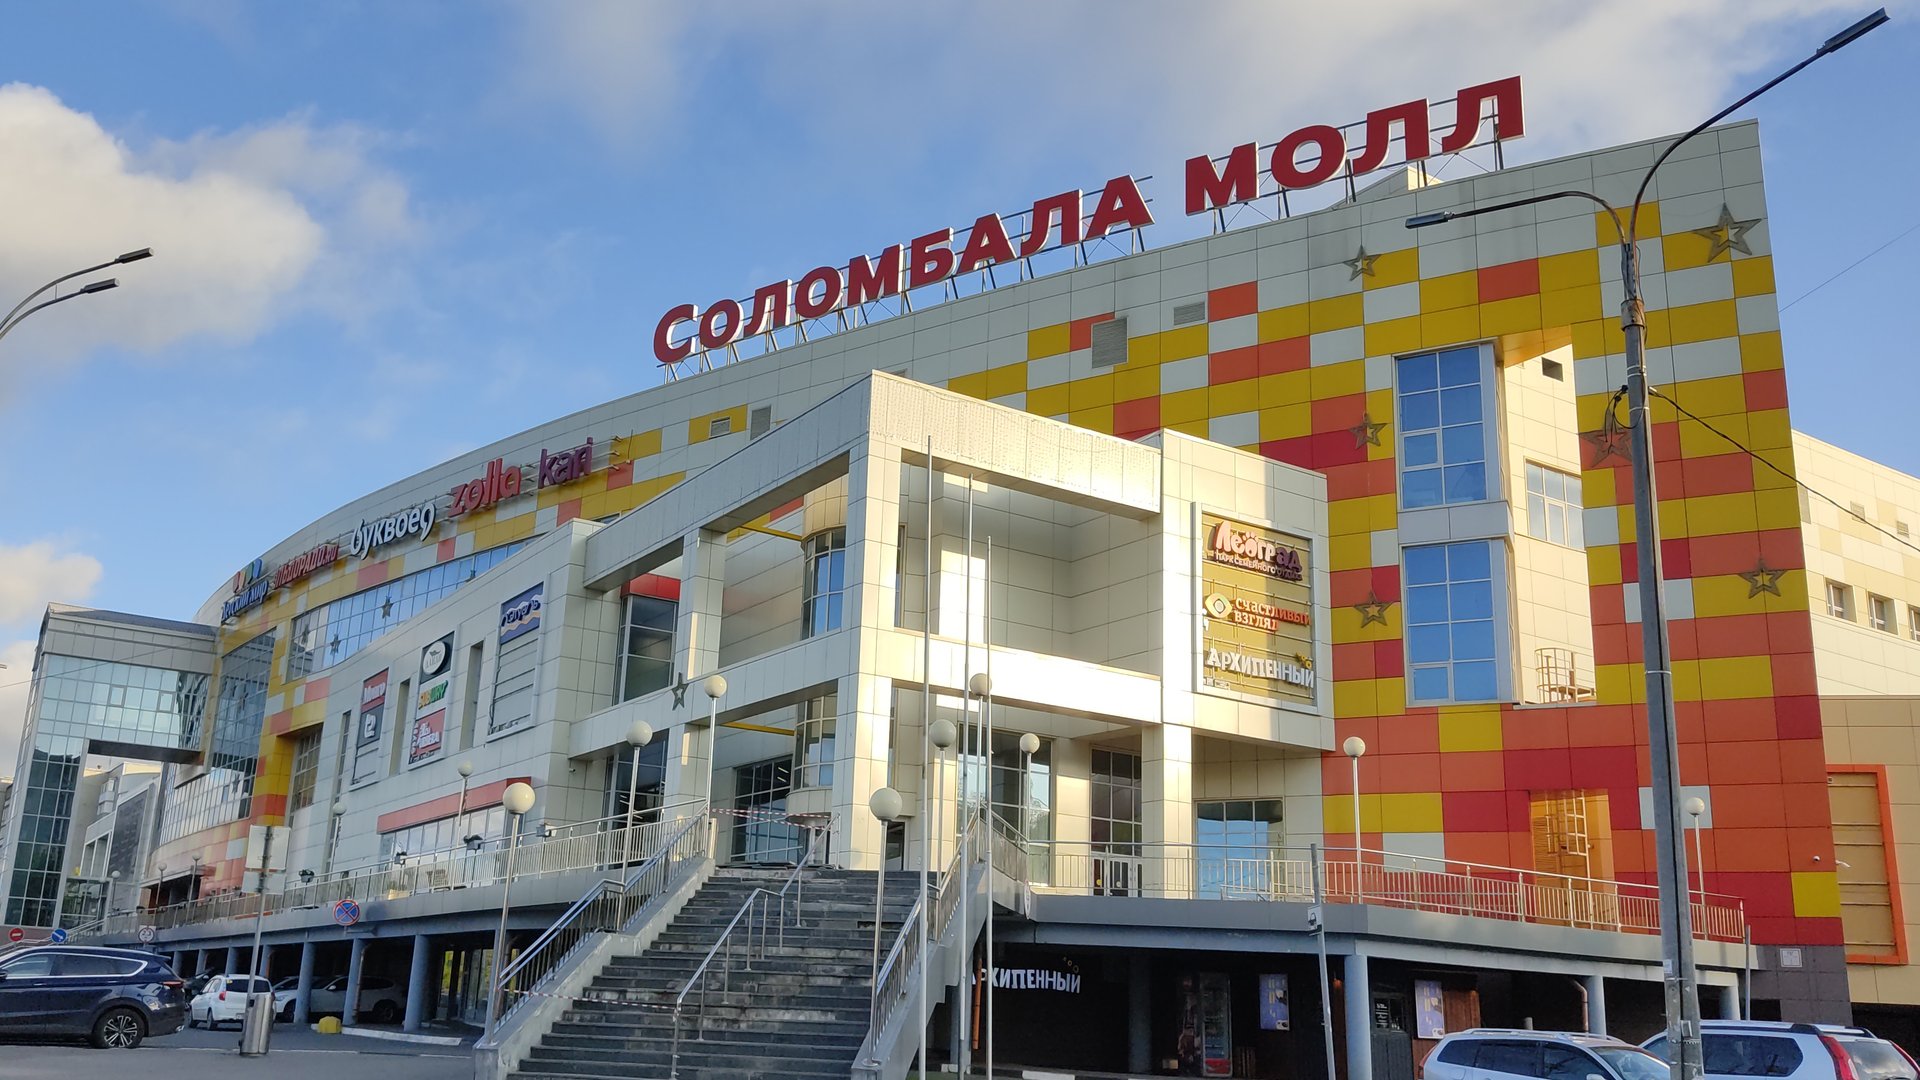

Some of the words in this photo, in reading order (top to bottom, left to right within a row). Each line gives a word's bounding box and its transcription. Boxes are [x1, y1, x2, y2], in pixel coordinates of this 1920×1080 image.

[653, 174, 1155, 364] СОЛОМБАЛА
[1185, 75, 1526, 217] МОЛЛ
[448, 458, 522, 518] zolla
[538, 437, 594, 489] kari
